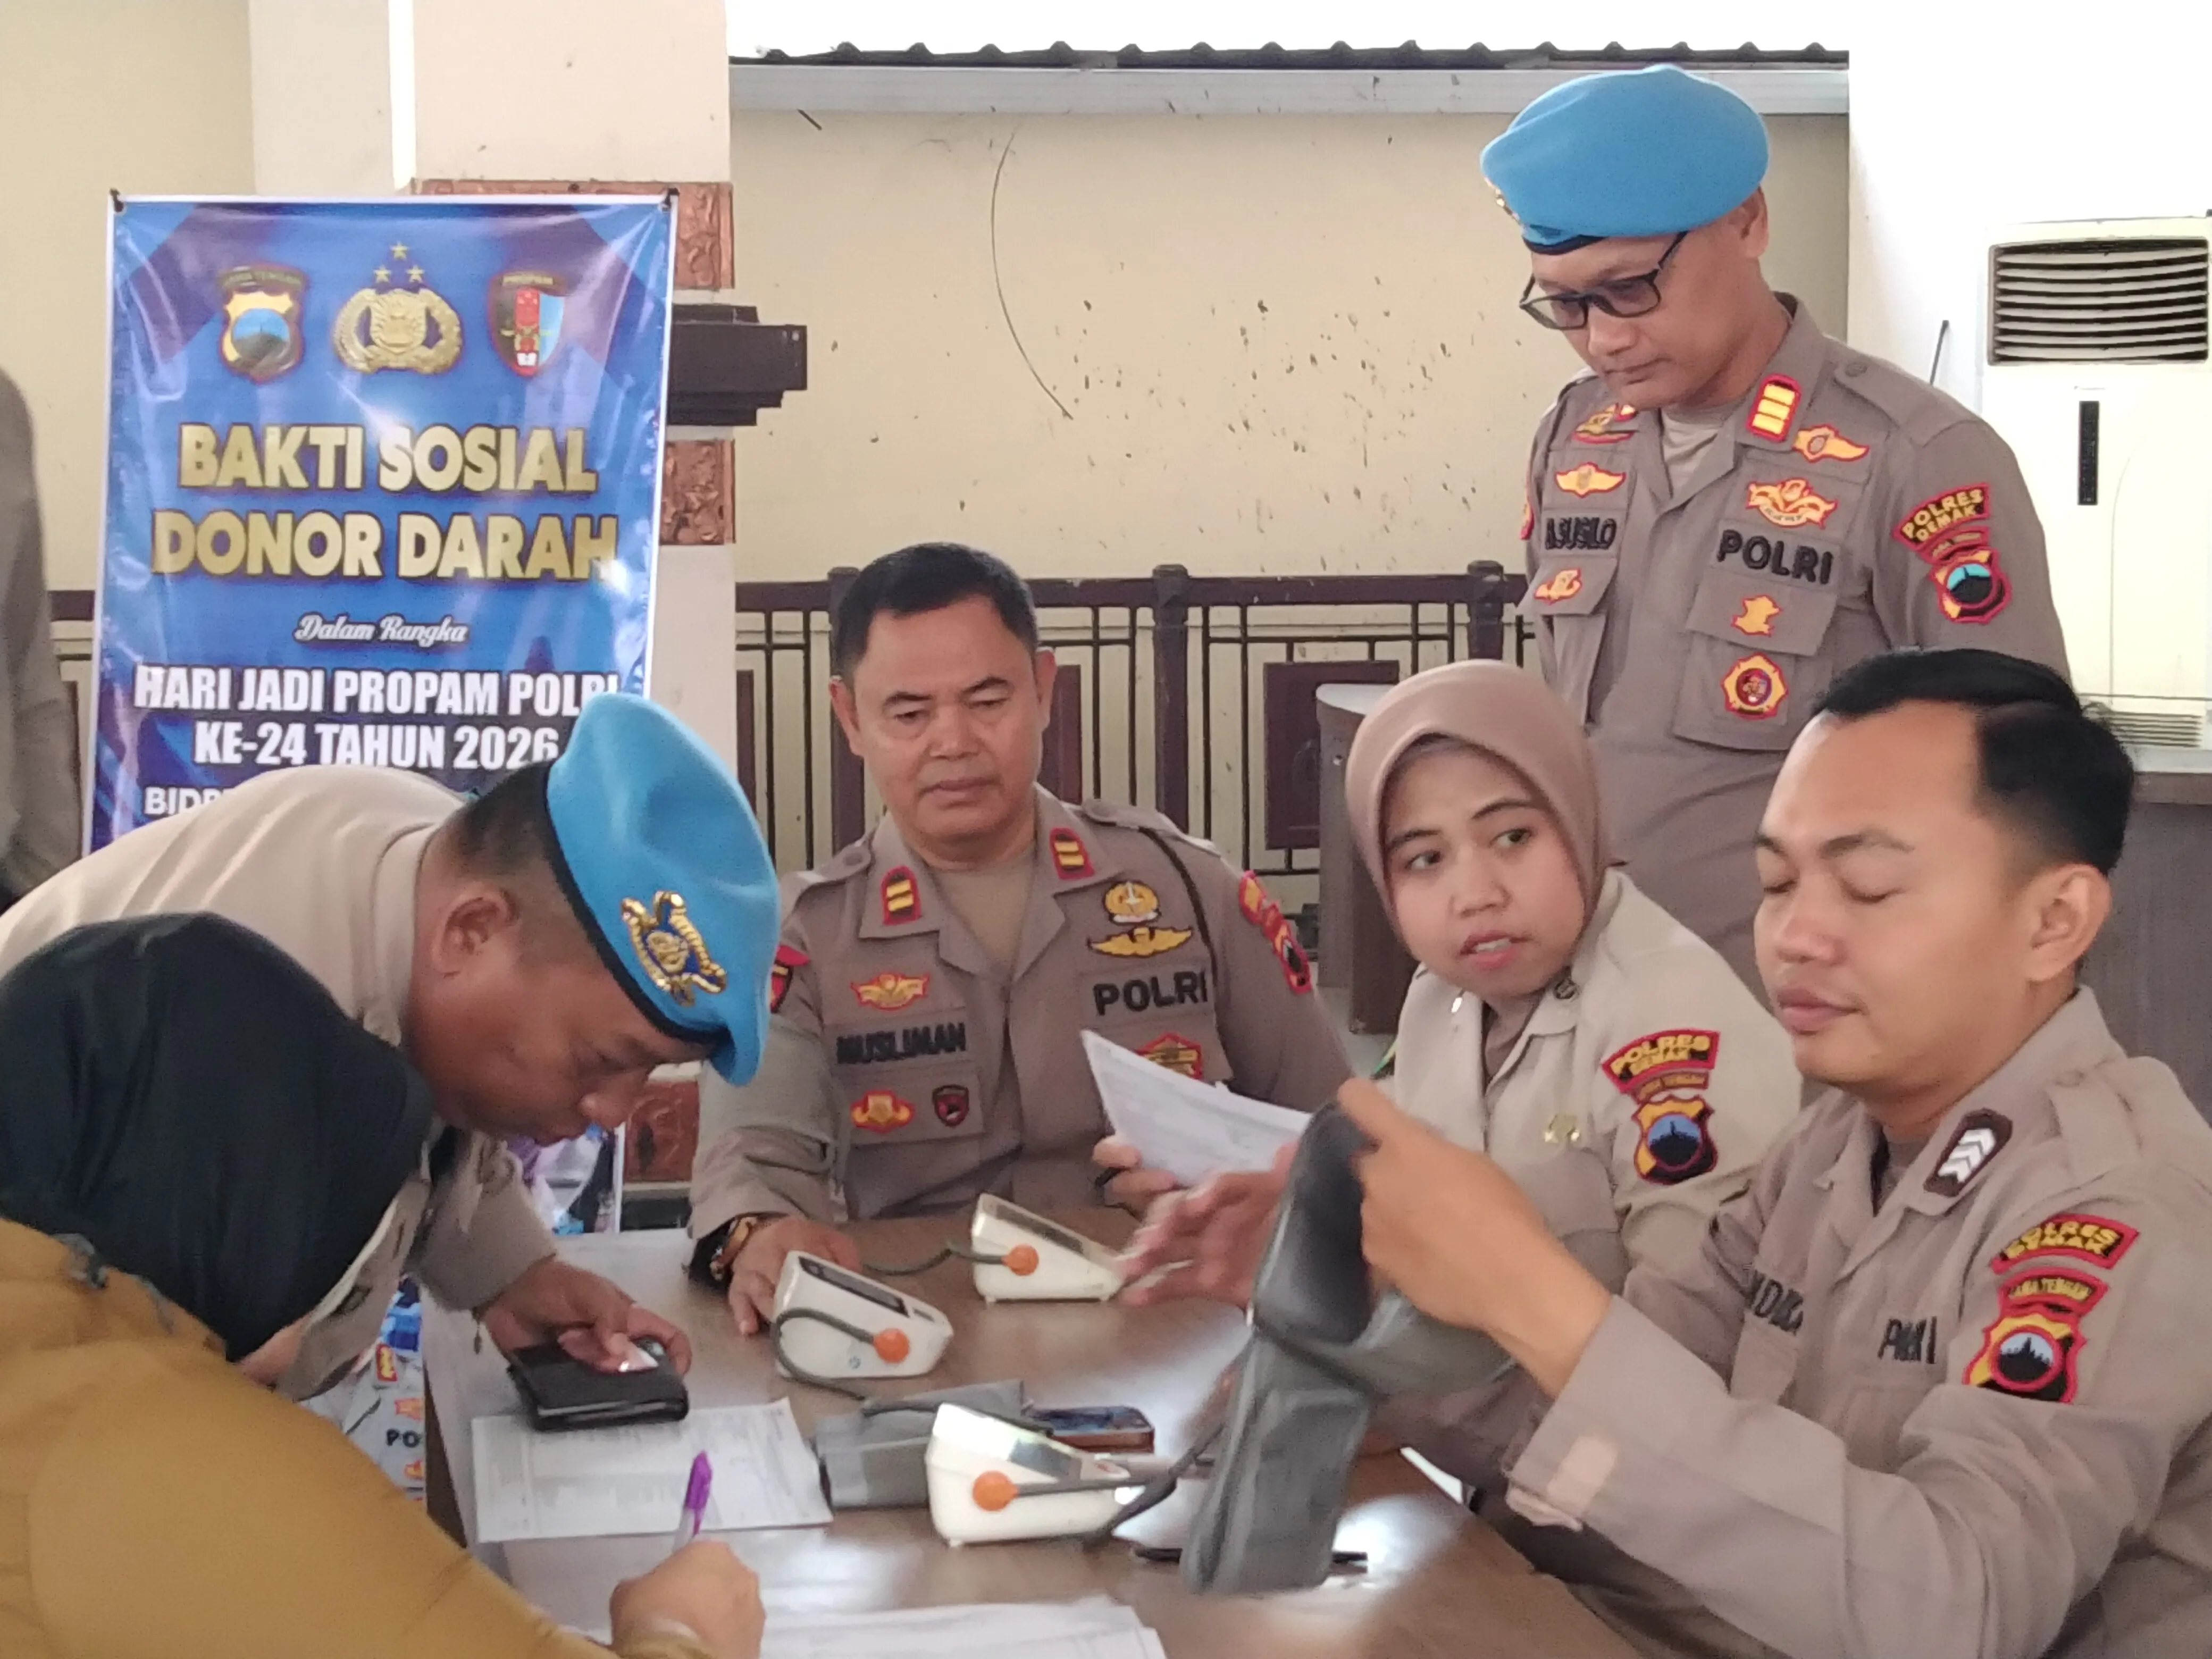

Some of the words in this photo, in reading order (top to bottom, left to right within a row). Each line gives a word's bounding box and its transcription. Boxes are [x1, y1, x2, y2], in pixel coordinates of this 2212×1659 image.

[180, 423, 365, 489] BAKTI
[377, 424, 599, 492] SOSIAL
[1901, 488, 1984, 539] POLRES
[1916, 504, 1977, 542] DEMAK
[151, 510, 383, 577] DONOR
[397, 513, 619, 581] DARAH
[1717, 529, 1833, 585] POLRI
[294, 614, 375, 642] Dalam
[378, 615, 468, 647] Rangka
[135, 665, 232, 710] HARI
[238, 667, 326, 712] JADI
[336, 668, 499, 717] PROPAM
[195, 722, 307, 765] KE-24
[314, 723, 446, 769] TAHUN
[453, 725, 559, 770] 2026
[1093, 968, 1208, 1016] POLRI
